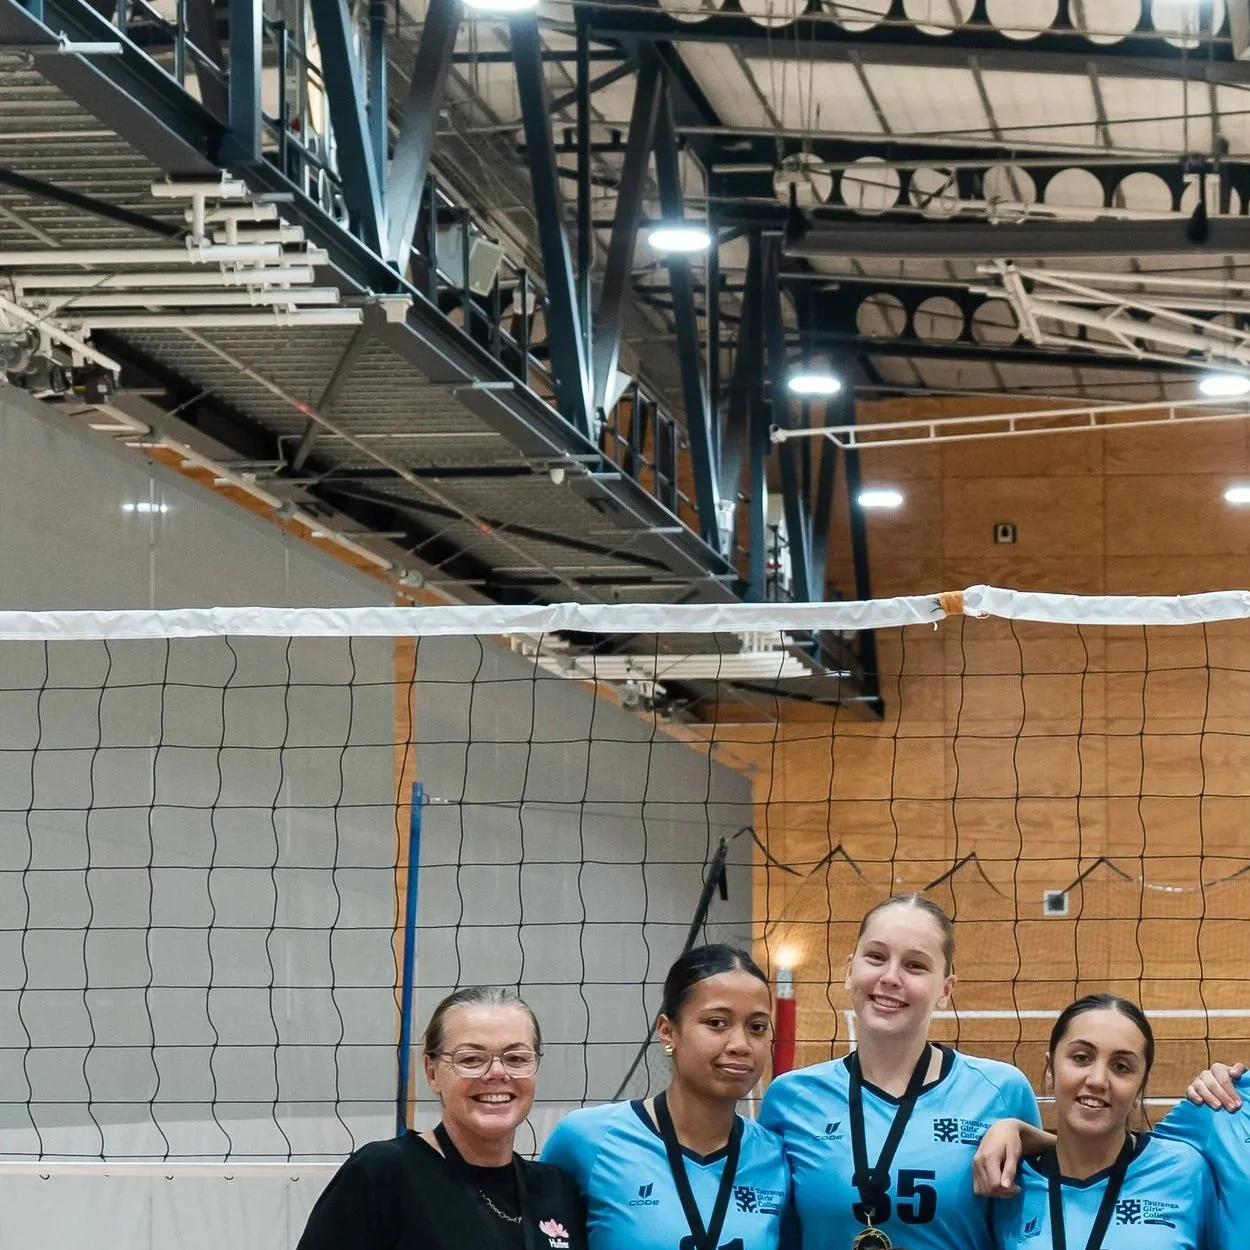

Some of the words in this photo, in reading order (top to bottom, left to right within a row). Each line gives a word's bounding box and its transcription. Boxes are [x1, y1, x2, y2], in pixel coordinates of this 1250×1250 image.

[961, 1119, 991, 1129] Taurang
[961, 1132, 982, 1140] Colle
[852, 1168, 937, 1225] 35
[1143, 1200, 1179, 1209] Tauranga
